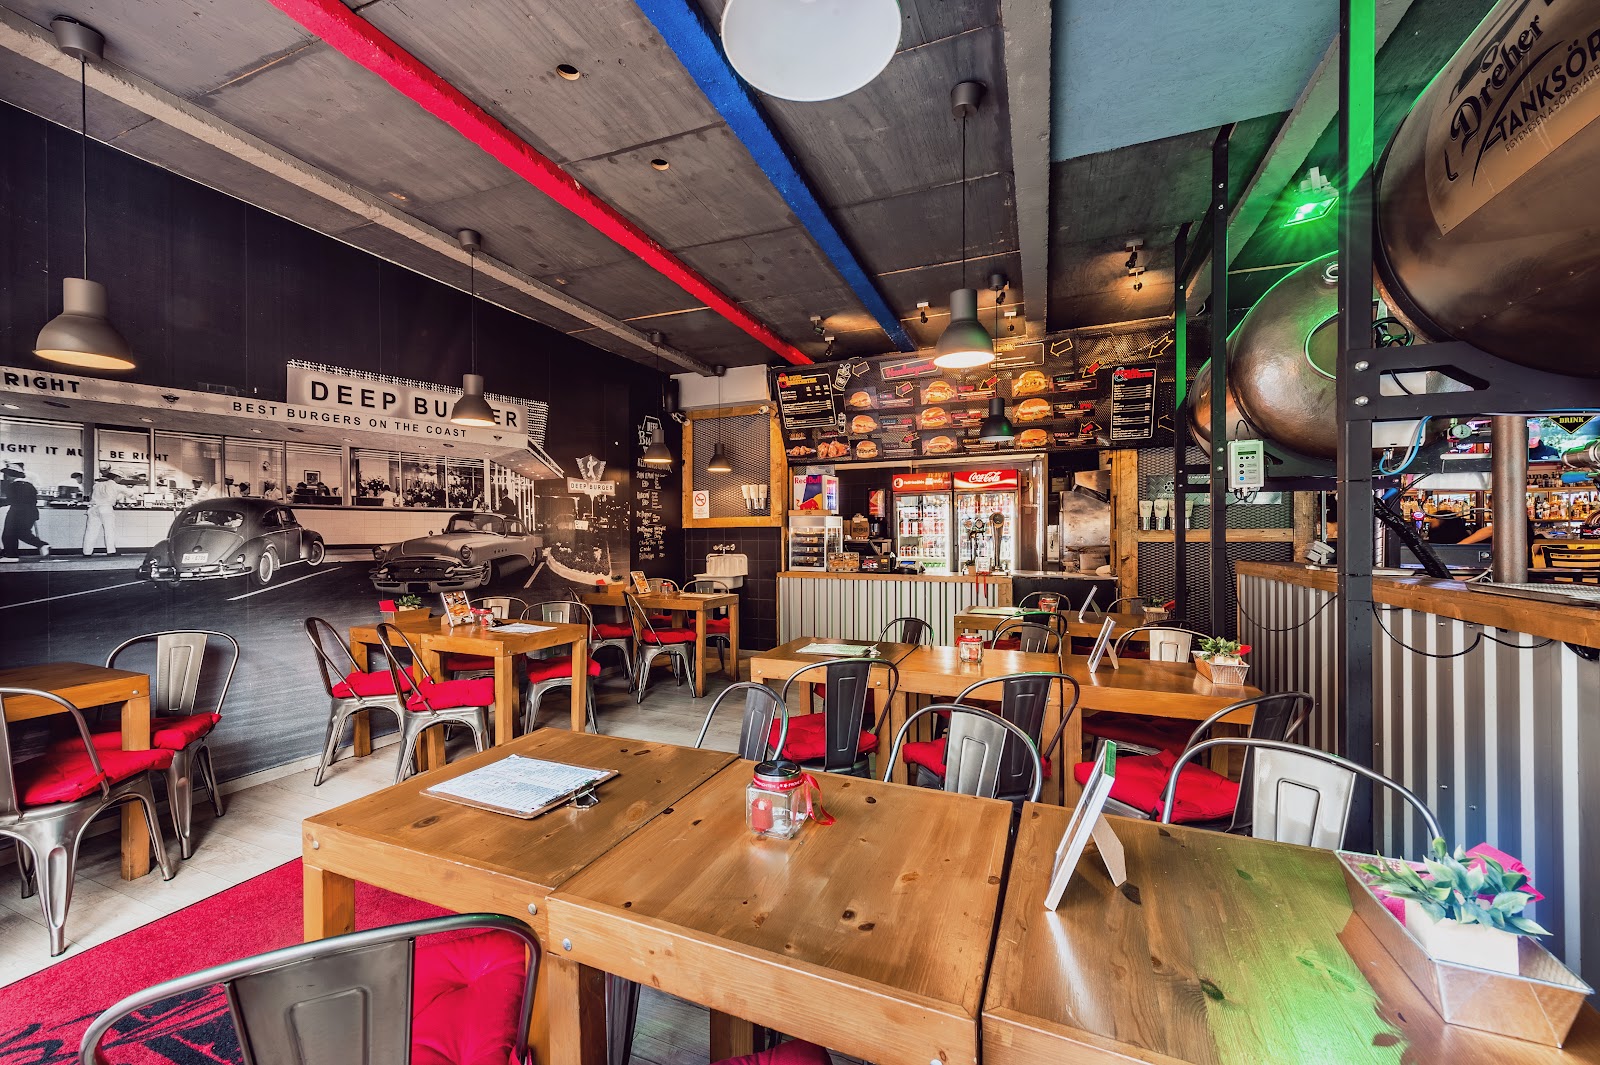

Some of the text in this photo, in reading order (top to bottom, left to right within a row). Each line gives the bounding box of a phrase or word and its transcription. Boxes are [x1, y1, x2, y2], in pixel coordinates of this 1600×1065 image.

[1451, 14, 1543, 156] Dreher
[1495, 28, 1600, 142] TANKSÖR
[1505, 112, 1547, 152] EGYENESEN
[1548, 106, 1555, 116] A
[4, 372, 80, 393] RIGHT
[311, 380, 517, 427] DEEP BUER
[233, 401, 467, 438] BEST BURGERS ON THE COAST
[1559, 416, 1585, 424] DRINK
[45, 446, 58, 455] IT
[110, 450, 124, 459] BE
[794, 476, 808, 485] Red
[968, 471, 1002, 483] Coca-Cola
